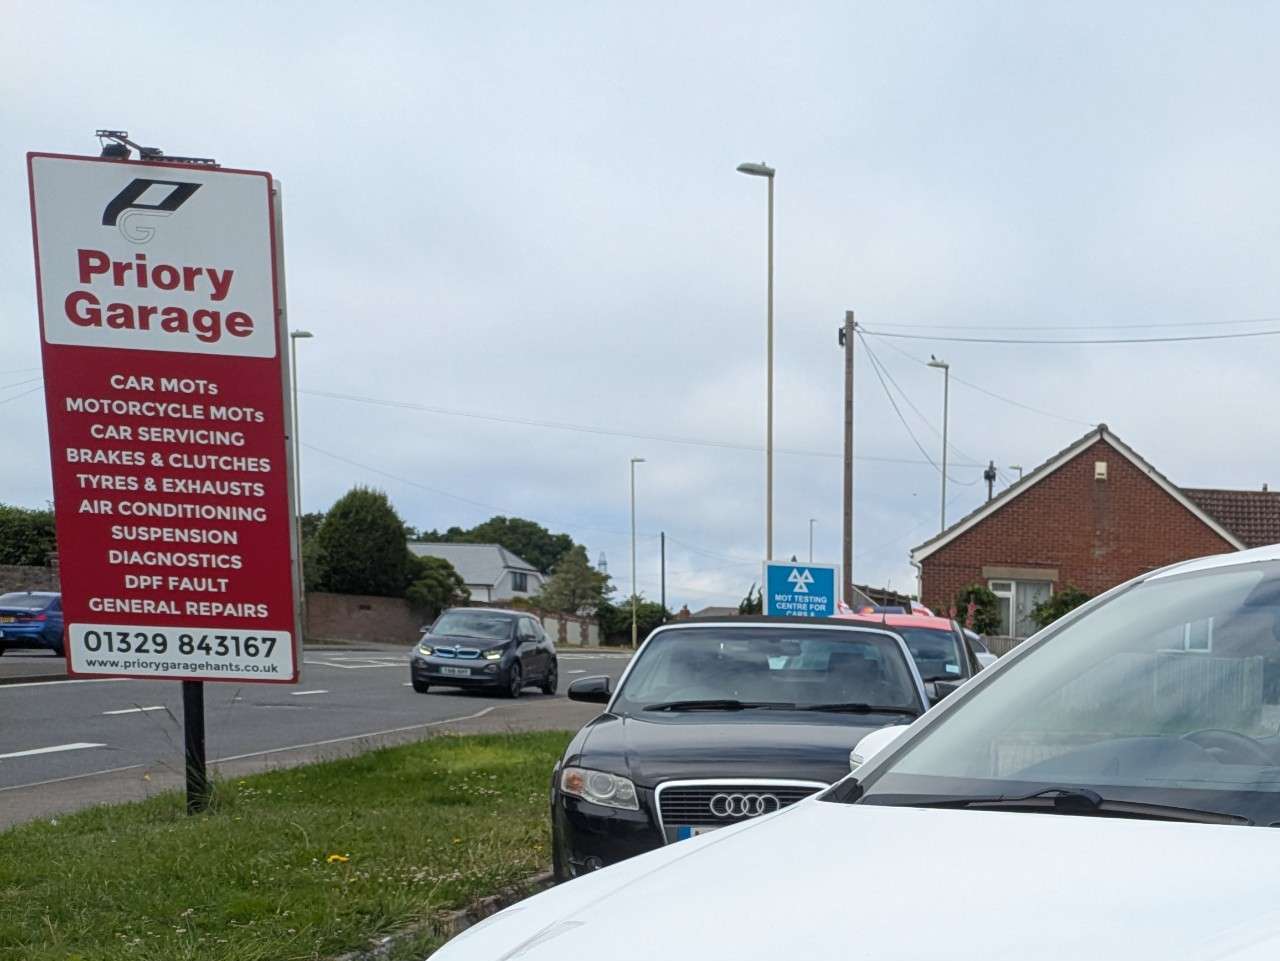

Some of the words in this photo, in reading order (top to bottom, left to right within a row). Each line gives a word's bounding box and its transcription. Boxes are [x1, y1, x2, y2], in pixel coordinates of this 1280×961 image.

[77, 248, 234, 301] Priory
[64, 290, 254, 343] Garage
[110, 374, 154, 392] CAR
[160, 377, 218, 395] MOTs
[66, 397, 204, 419] MOTORCYCLE
[210, 405, 264, 423] MOTs
[90, 424, 132, 441] CAR
[138, 426, 245, 446] SERVICING
[66, 448, 145, 466] BRAKES
[151, 452, 164, 467] &
[168, 453, 271, 472] CLUTCHES
[76, 473, 138, 491] TYRES
[144, 477, 157, 492] &
[163, 478, 264, 497] EXHAUSTS
[79, 499, 112, 515] AIR
[118, 501, 267, 522] CONDITIONING
[111, 525, 238, 545] SUSPENSION
[108, 550, 242, 569] DIAGNOSTICS
[125, 574, 163, 590] DPF
[168, 576, 229, 593] FAULT
[88, 597, 181, 615] GENERAL
[186, 600, 268, 618] REPAIRS
[774, 594, 792, 602] MOT
[794, 595, 827, 603] TESTING
[776, 602, 808, 610] CENTRE
[83, 630, 168, 655] 01329
[178, 633, 277, 658] 843167
[86, 657, 279, 674] www.priorygaragehants.co.uk
